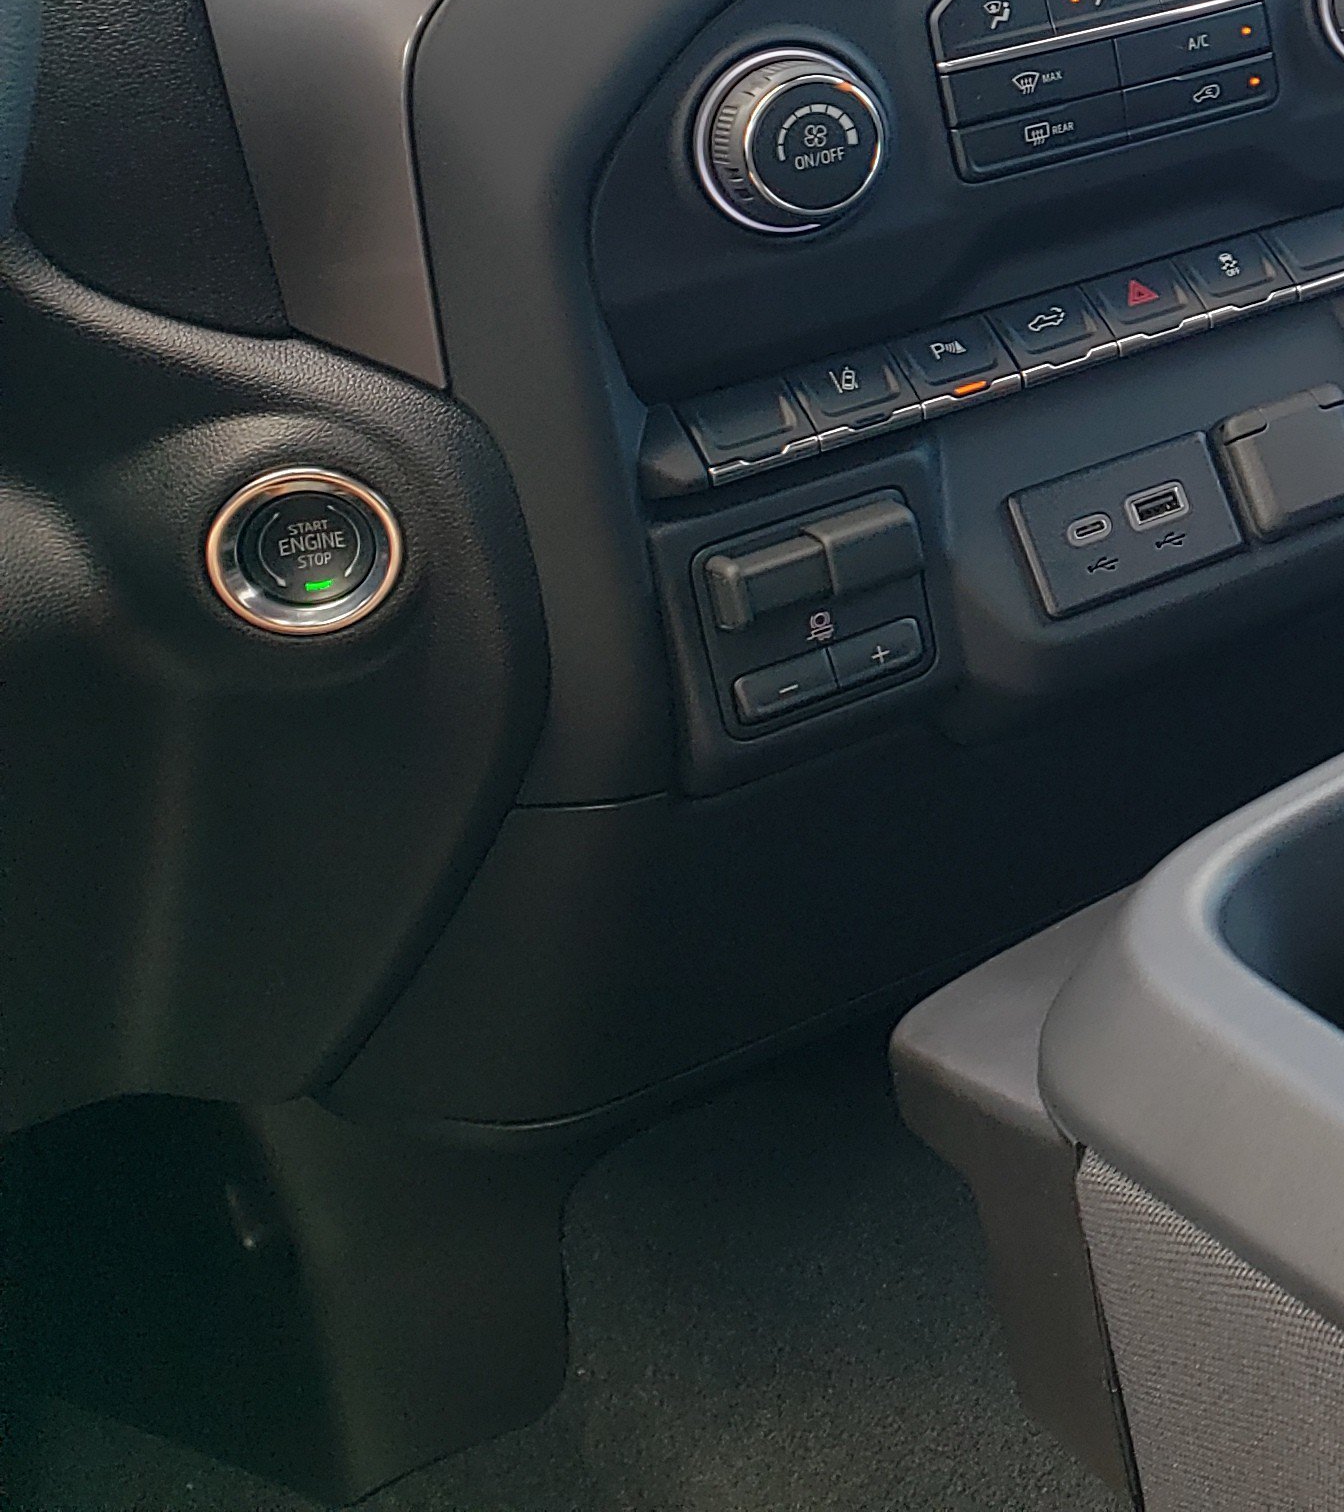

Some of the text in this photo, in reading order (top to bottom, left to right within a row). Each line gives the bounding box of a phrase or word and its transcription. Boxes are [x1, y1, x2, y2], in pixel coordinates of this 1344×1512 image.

[1187, 34, 1210, 51] A/C
[1042, 70, 1063, 84] MAX
[1051, 121, 1074, 136] REAR
[794, 146, 845, 170] ON/OFF
[287, 519, 328, 536] START
[278, 531, 347, 557] ENGINE
[297, 552, 332, 569] STOP
